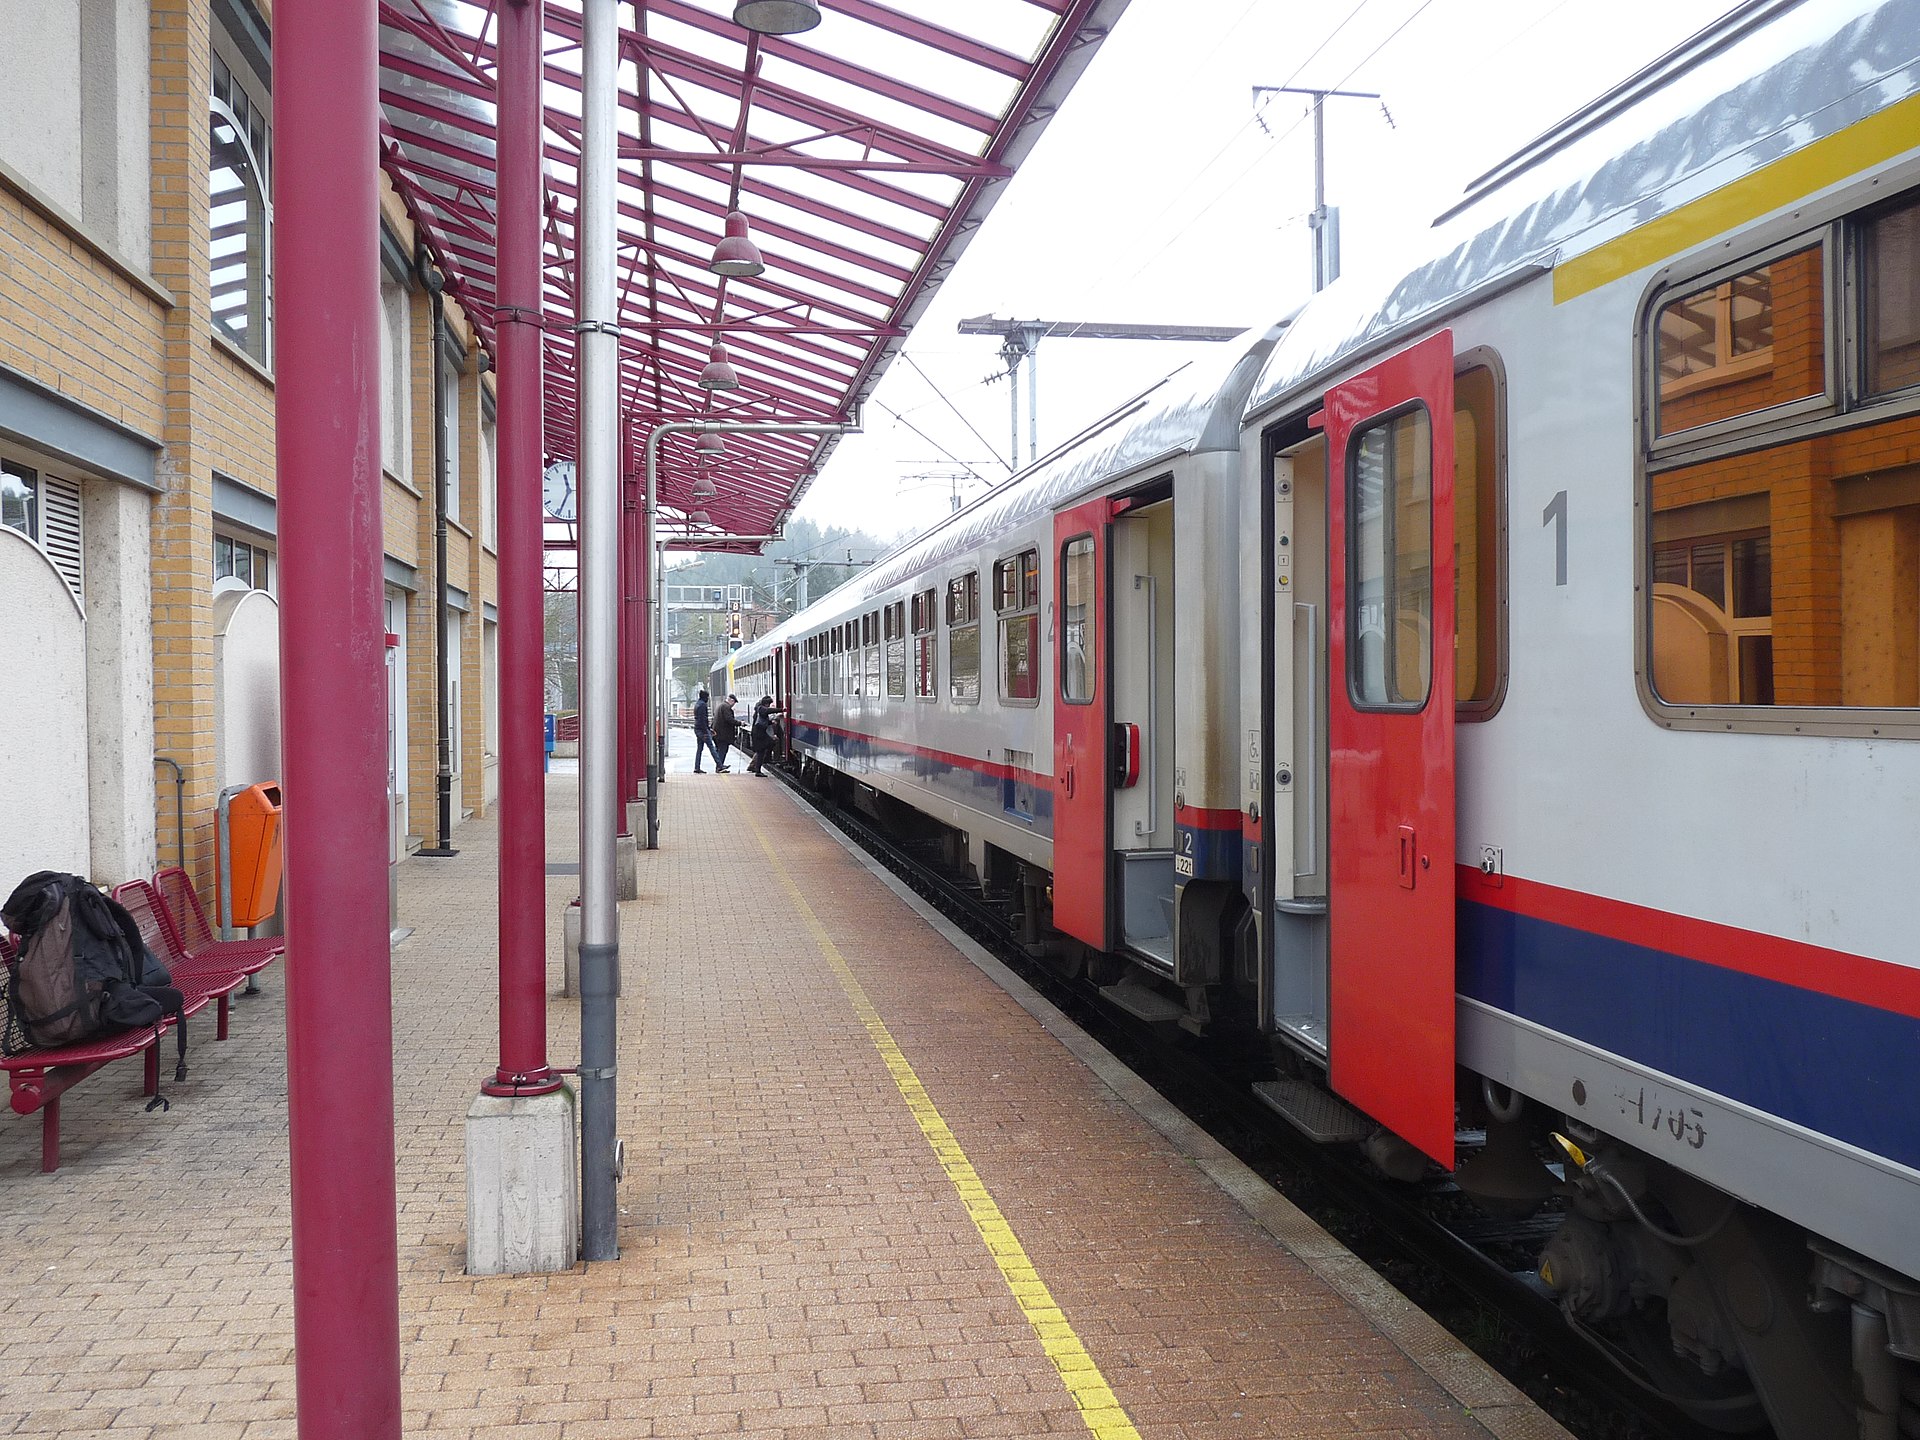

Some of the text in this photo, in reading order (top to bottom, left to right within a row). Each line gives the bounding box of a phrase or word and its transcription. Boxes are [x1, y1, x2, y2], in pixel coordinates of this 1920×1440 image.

[1543, 490, 1568, 586] 1
[1185, 832, 1193, 855] 2
[1251, 886, 1257, 908] 1
